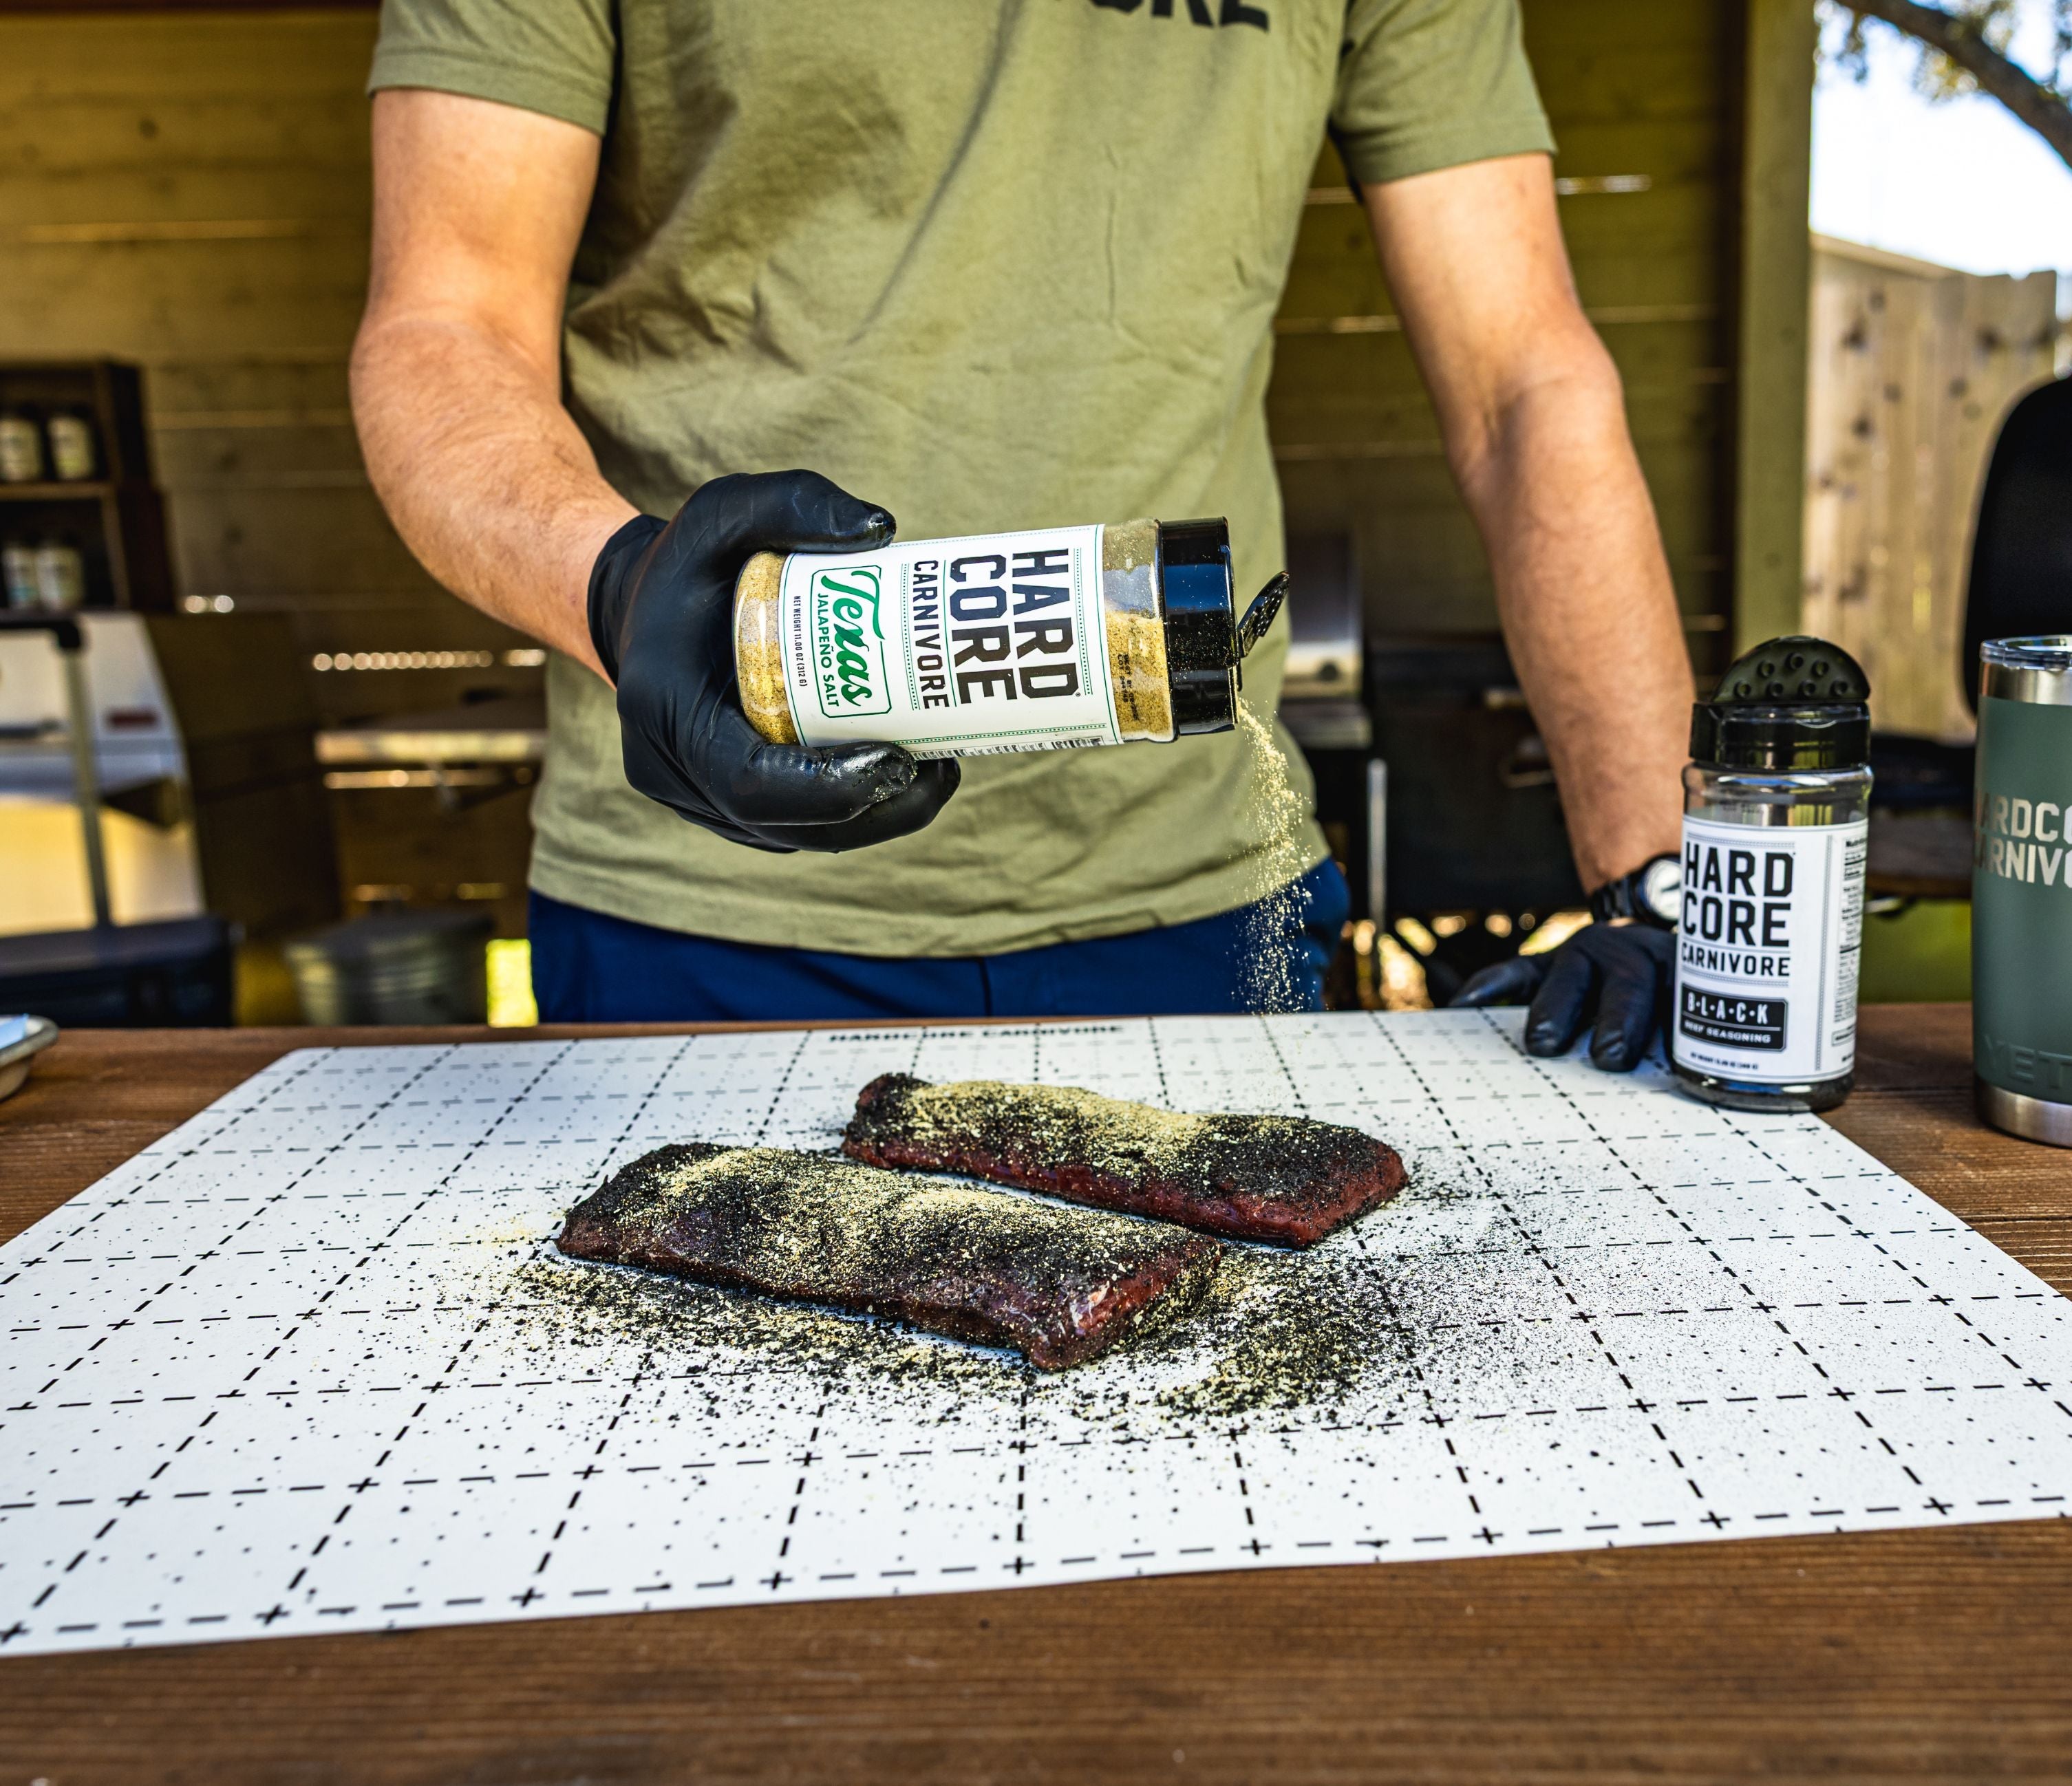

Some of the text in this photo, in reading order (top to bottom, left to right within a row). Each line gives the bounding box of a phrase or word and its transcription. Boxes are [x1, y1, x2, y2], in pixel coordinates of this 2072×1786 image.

[793, 608, 802, 632] WEIGHT
[794, 634, 802, 651] 11.00
[821, 570, 885, 707] Texas
[913, 560, 950, 709] CARNIVORE
[950, 555, 1017, 704] CORE
[1012, 548, 1078, 698] HARD
[795, 653, 804, 661] OZ
[797, 663, 806, 678] (312
[818, 593, 840, 707] JALAPEÑO SALT
[1685, 841, 1793, 897] HARD
[1683, 891, 1791, 947] CORE
[1682, 943, 1791, 976] CARNIVORE
[1707, 1027, 1771, 1044] SEASONING
